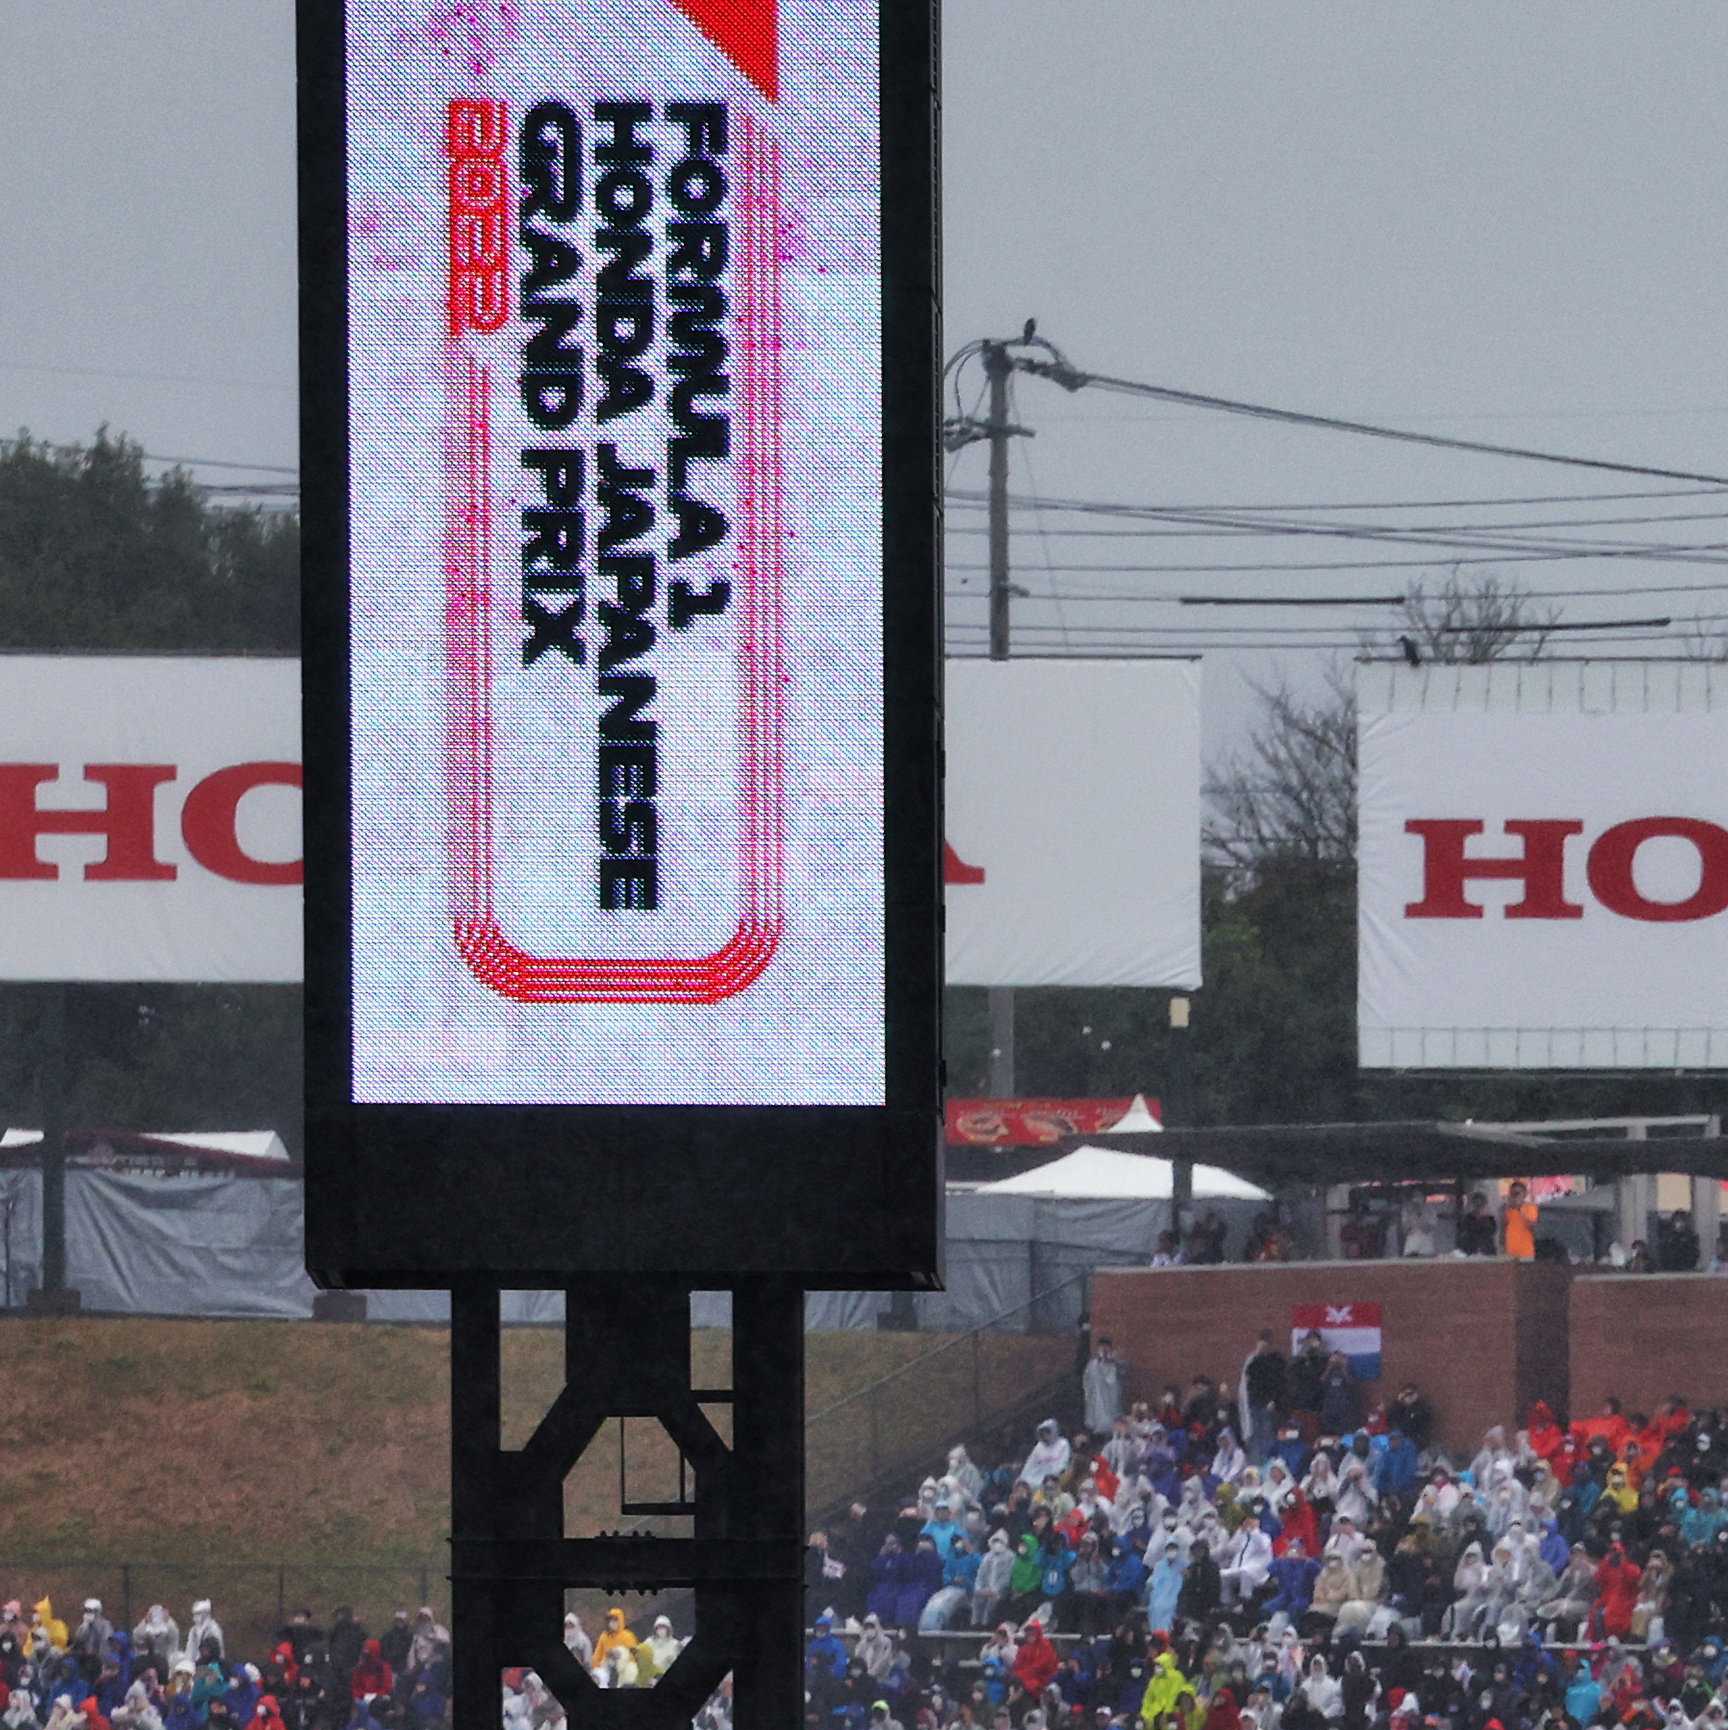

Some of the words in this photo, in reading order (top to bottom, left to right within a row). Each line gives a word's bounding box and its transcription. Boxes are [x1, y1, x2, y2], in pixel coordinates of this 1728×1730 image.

[447, 100, 508, 336] 2022
[520, 101, 582, 432] GRAND
[594, 101, 653, 426] HONDA
[665, 101, 728, 561] FORMULA
[521, 448, 585, 667] PRIX
[597, 443, 657, 911] JAPANESE
[667, 578, 729, 631] 1
